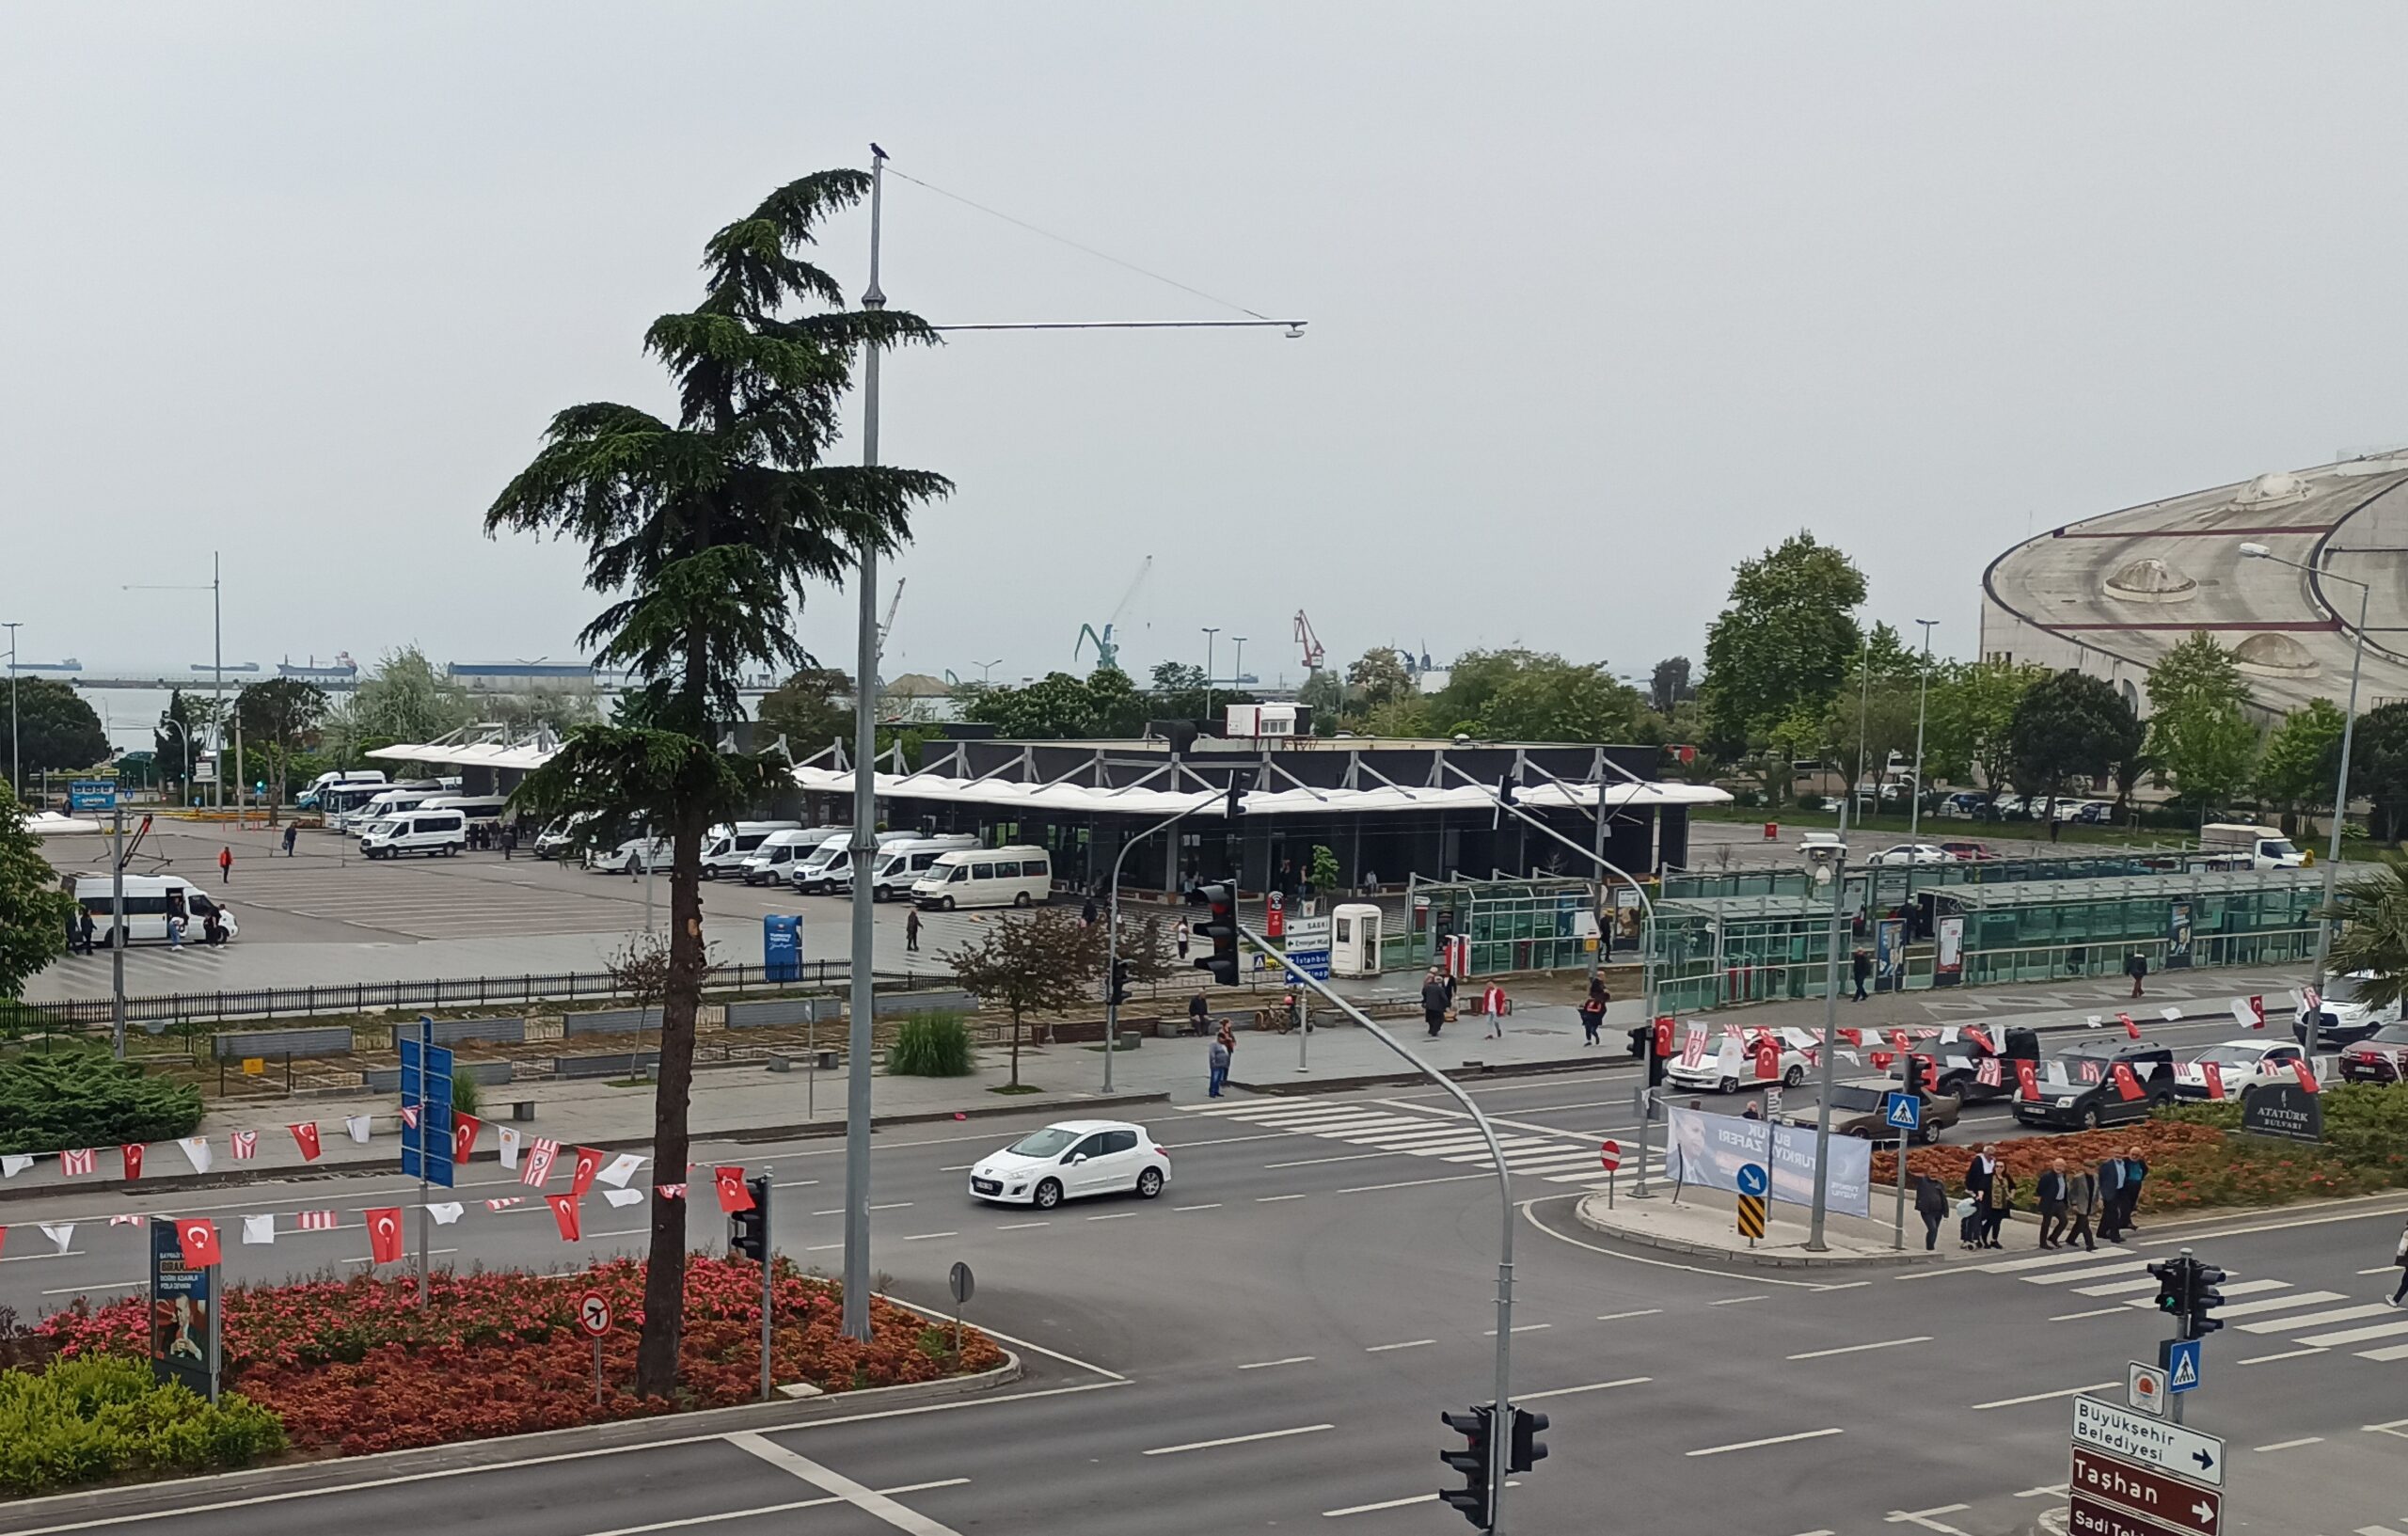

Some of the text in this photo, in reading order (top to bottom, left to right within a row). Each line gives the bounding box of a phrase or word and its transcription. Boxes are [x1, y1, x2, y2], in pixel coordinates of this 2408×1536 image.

[2258, 1107, 2308, 1122] ATATÜRK
[2264, 1118, 2302, 1130] BULVARI
[2080, 1403, 2175, 1446] Büyükşehir
[2078, 1421, 2162, 1462] Belediyesi
[2075, 1460, 2158, 1504] Taşhan
[2075, 1510, 2109, 1535] Sadi
